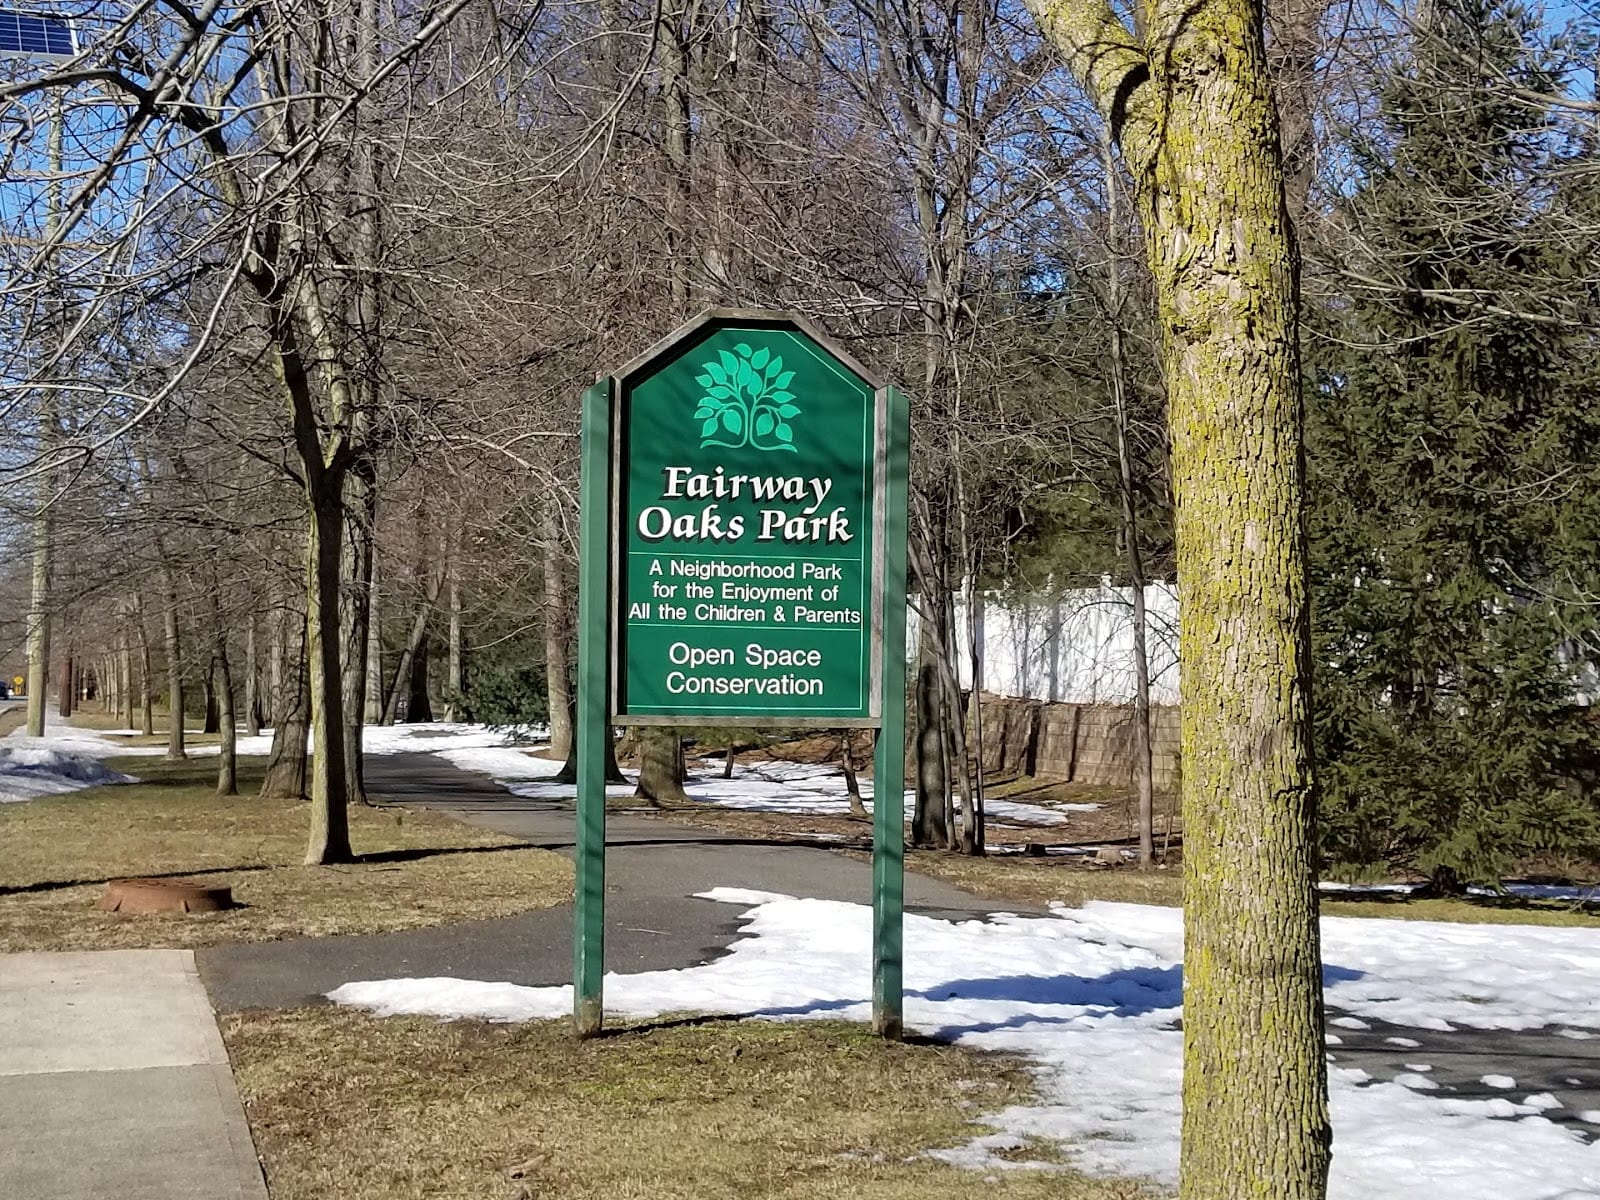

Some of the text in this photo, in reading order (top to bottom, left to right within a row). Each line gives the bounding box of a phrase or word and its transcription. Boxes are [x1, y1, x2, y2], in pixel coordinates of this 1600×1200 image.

[662, 466, 832, 514] Fairway
[638, 504, 854, 542] Oaks Park
[649, 559, 842, 580] A Neighborhood Park
[652, 581, 839, 603] for the Enjoyment of
[629, 603, 861, 624] All the Children & Parents
[669, 641, 822, 669] Open Space
[666, 671, 824, 695] Conservation
